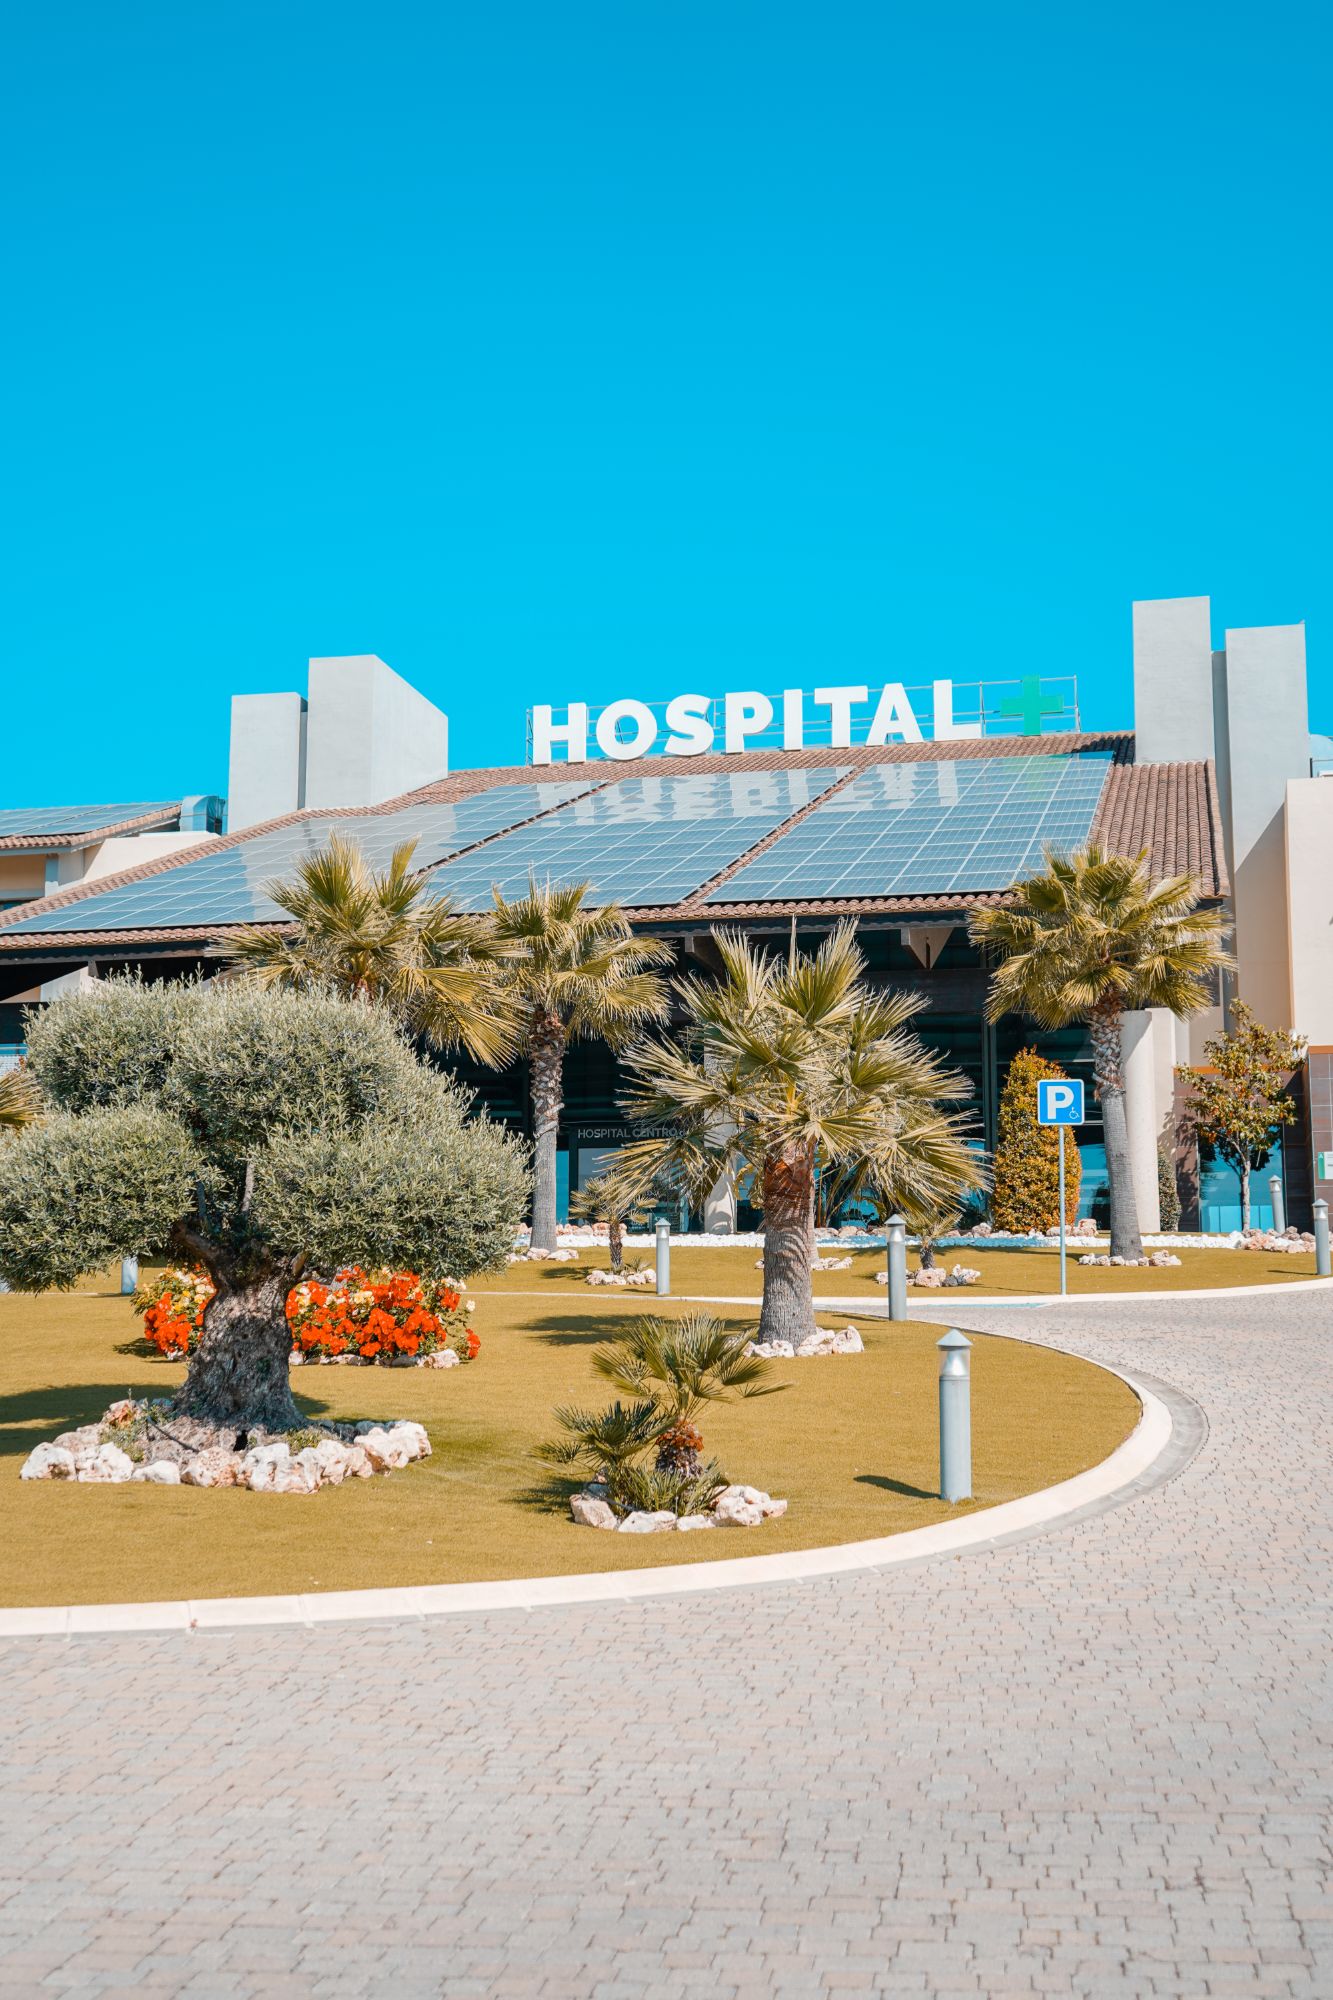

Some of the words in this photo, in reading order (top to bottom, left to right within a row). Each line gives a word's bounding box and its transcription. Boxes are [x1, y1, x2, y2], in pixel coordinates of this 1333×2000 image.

[532, 679, 982, 765] HOSPITAL
[1047, 1086, 1074, 1119] P
[578, 1129, 631, 1139] HOSPITAL
[632, 1127, 678, 1138] CENTRO
